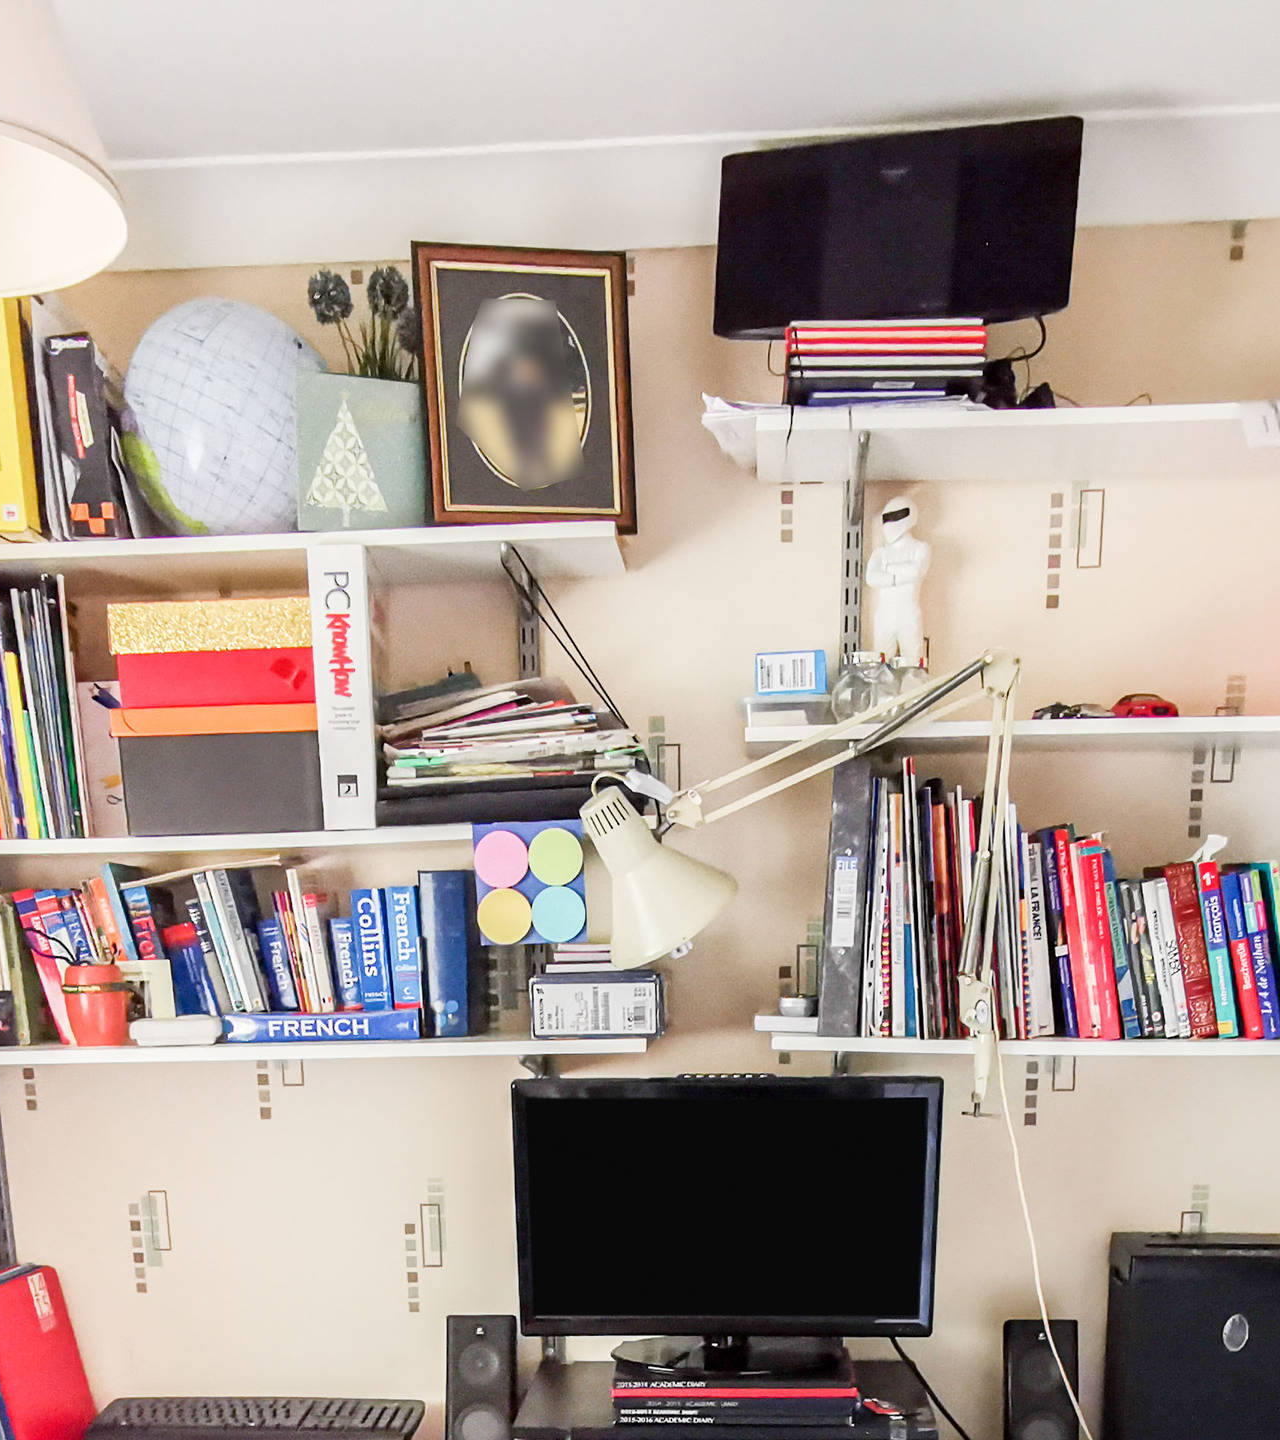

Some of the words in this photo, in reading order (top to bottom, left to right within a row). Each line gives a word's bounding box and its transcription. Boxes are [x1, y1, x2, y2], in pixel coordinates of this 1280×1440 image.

[324, 572, 352, 610] PC
[835, 857, 858, 871] FILE
[1030, 886, 1040, 900] LA
[357, 897, 381, 977] Collins
[393, 892, 416, 961] French
[1209, 896, 1224, 943] Français
[269, 941, 289, 990] French
[338, 932, 358, 988] French
[1253, 935, 1266, 974] Nathan
[1257, 979, 1267, 992] de
[268, 1017, 370, 1038] FRENCH
[620, 1416, 653, 1424] 2015-2016
[654, 1416, 692, 1424] ACADEMIC
[693, 1416, 715, 1424] DIARY
